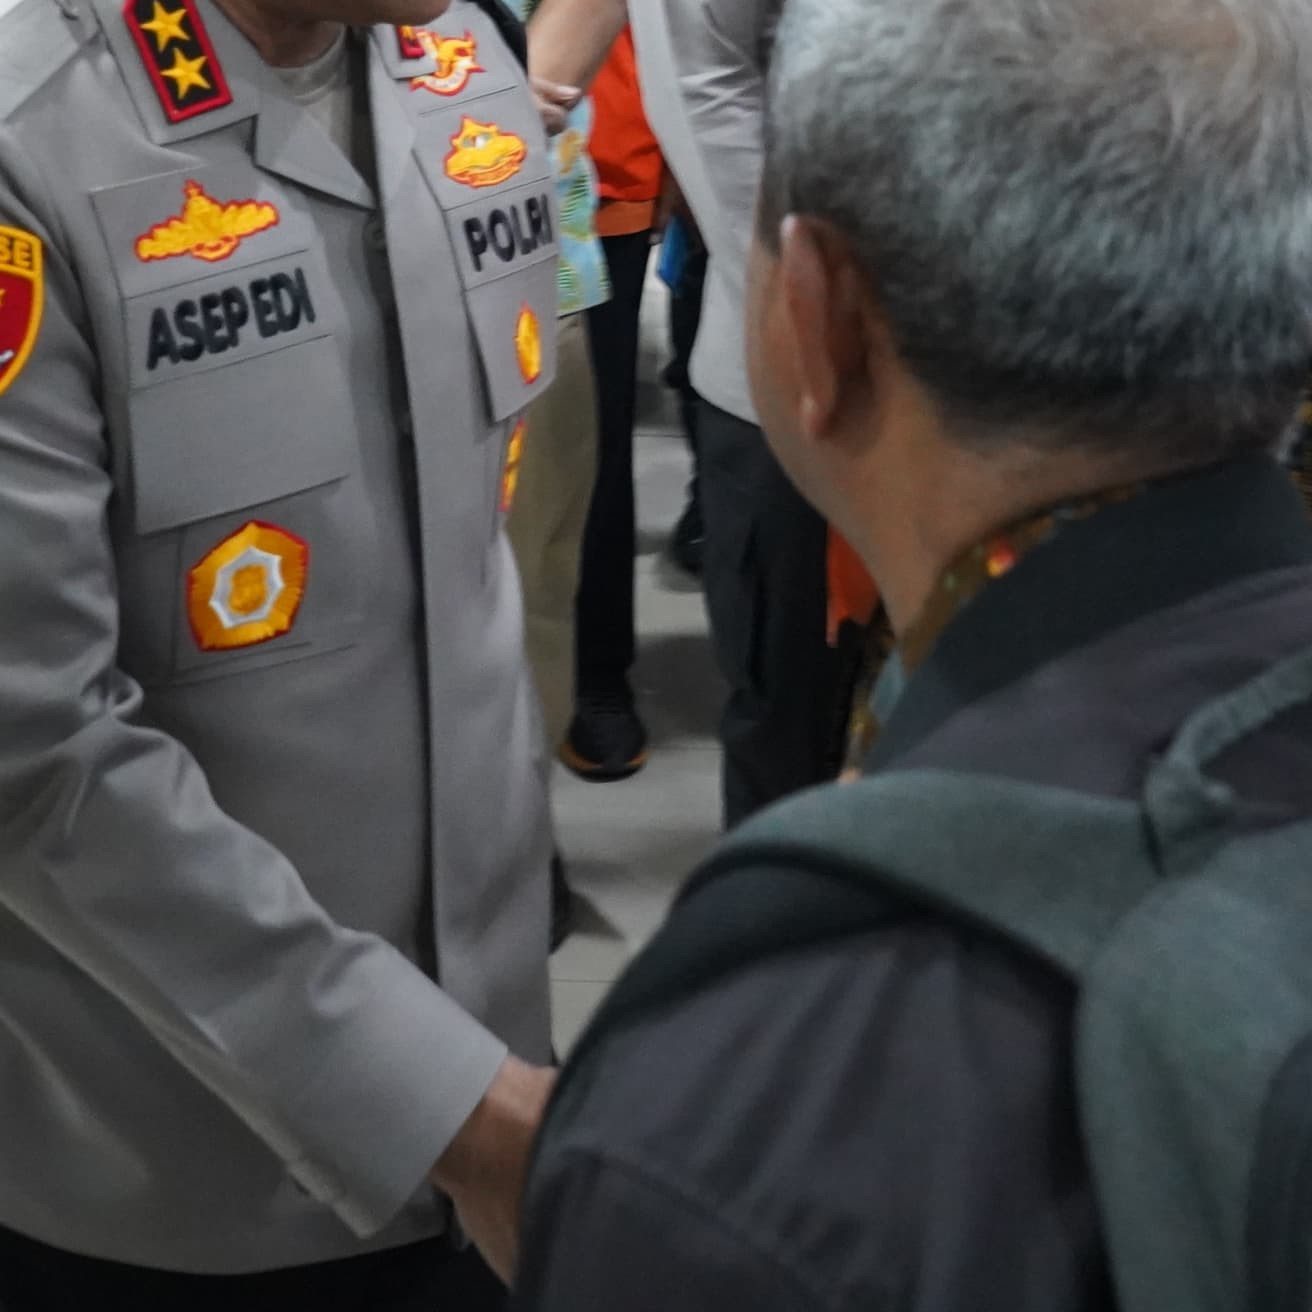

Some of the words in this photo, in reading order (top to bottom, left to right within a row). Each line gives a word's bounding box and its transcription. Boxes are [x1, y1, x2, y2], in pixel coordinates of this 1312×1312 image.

[463, 193, 553, 273] POLRI
[146, 285, 249, 371] ASEP
[248, 267, 316, 339] EDI
